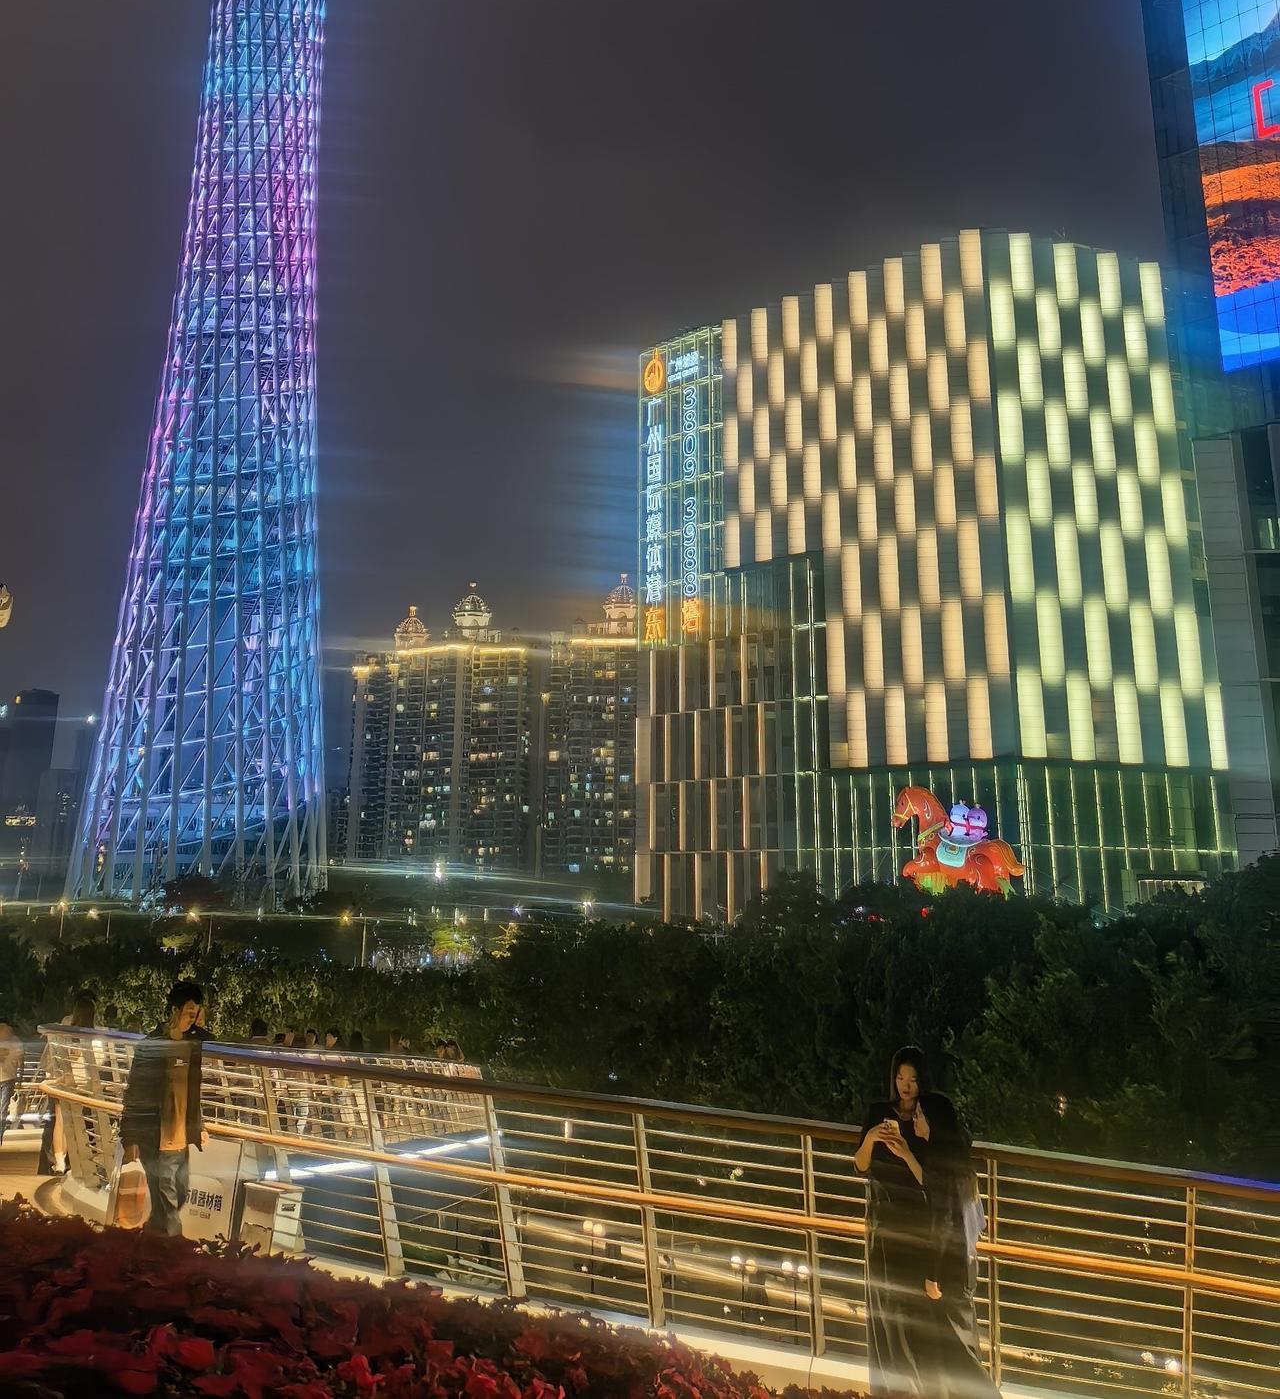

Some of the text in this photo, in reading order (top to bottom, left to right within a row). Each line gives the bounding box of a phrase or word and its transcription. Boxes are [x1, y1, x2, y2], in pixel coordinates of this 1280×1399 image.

[683, 386, 697, 481] 3809
[646, 398, 662, 604] 广州国际媒体港
[683, 497, 697, 596] 3988
